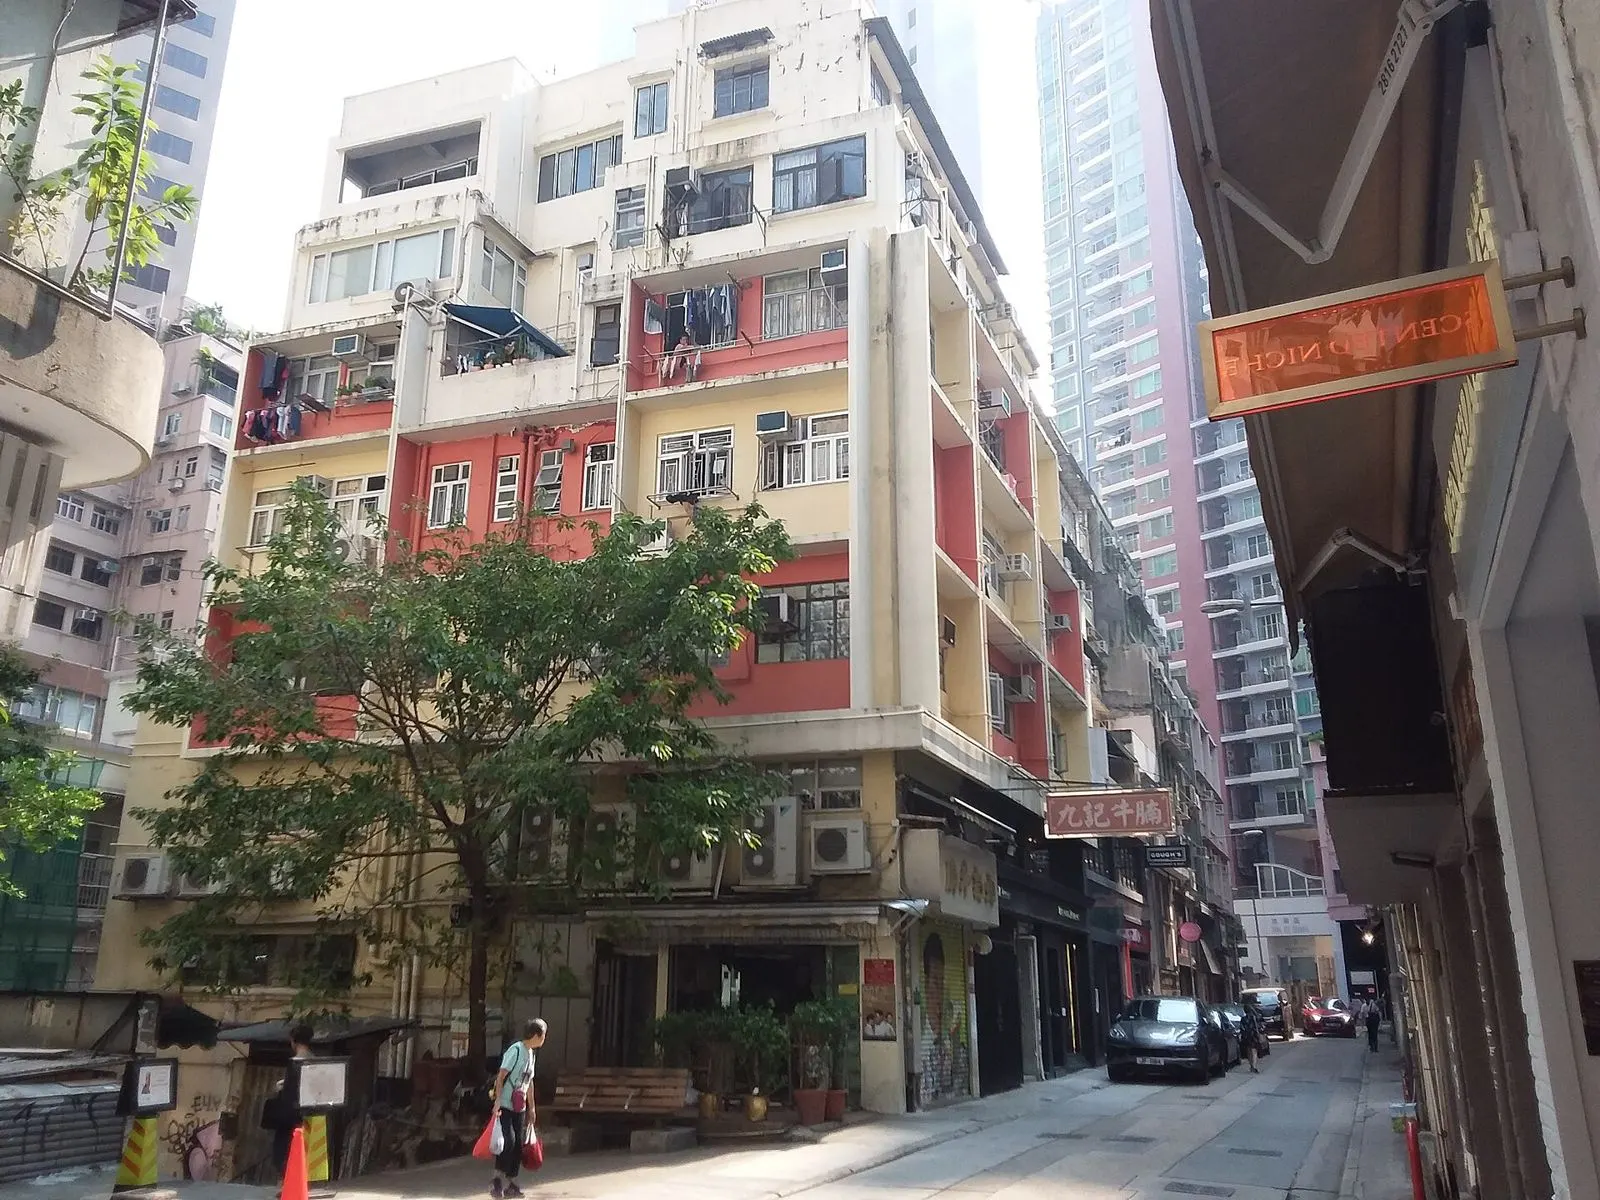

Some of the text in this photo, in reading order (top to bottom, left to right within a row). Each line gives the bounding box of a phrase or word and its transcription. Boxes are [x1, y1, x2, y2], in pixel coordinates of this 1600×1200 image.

[1377, 24, 1408, 95] 2816 2727
[1056, 798, 1162, 828] 九記牛腩
